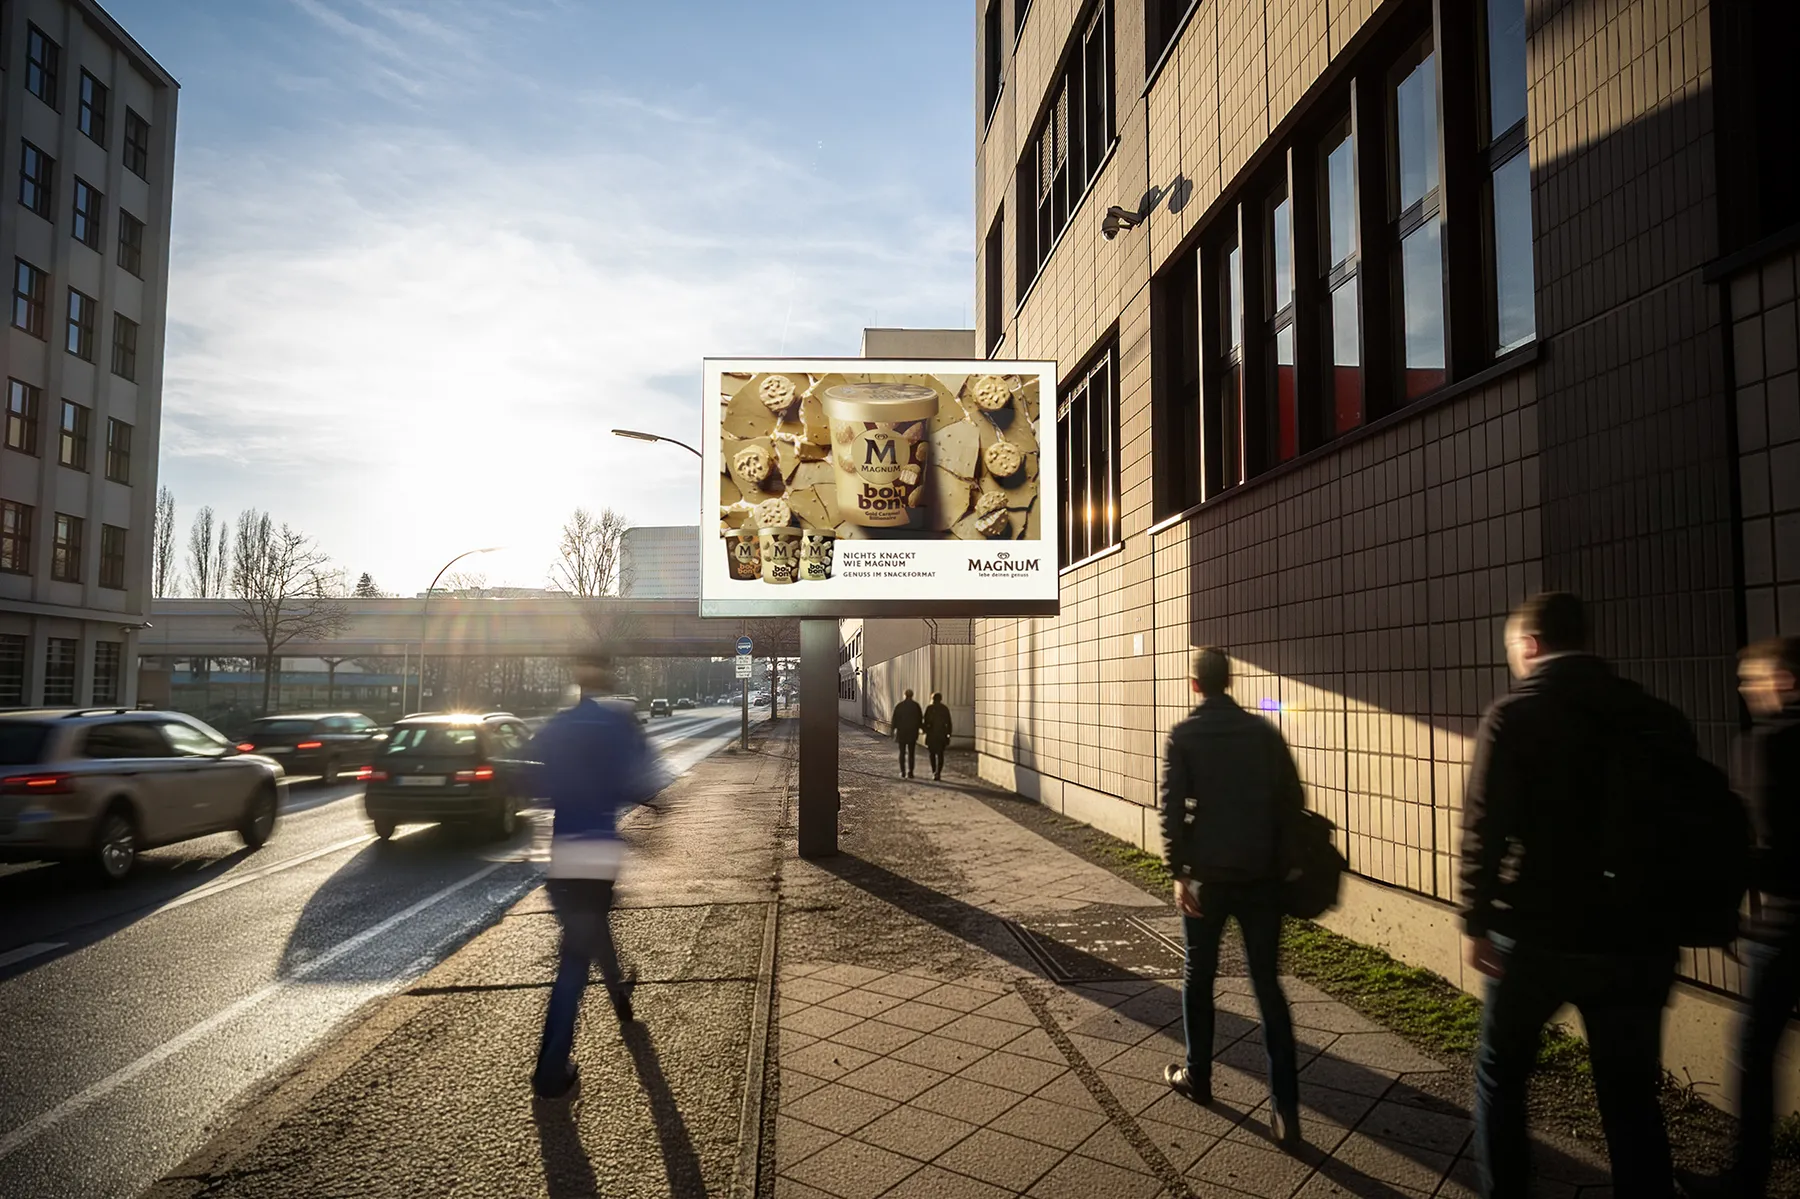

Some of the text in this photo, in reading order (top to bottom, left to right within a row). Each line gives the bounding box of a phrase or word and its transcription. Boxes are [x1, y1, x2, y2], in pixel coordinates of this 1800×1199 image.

[864, 438, 898, 464] M
[861, 464, 900, 473] MAGNUM
[863, 483, 906, 498] bon
[740, 546, 751, 556] M
[774, 546, 788, 557] M
[810, 546, 822, 556] M
[968, 558, 1041, 572] MAGNUM
